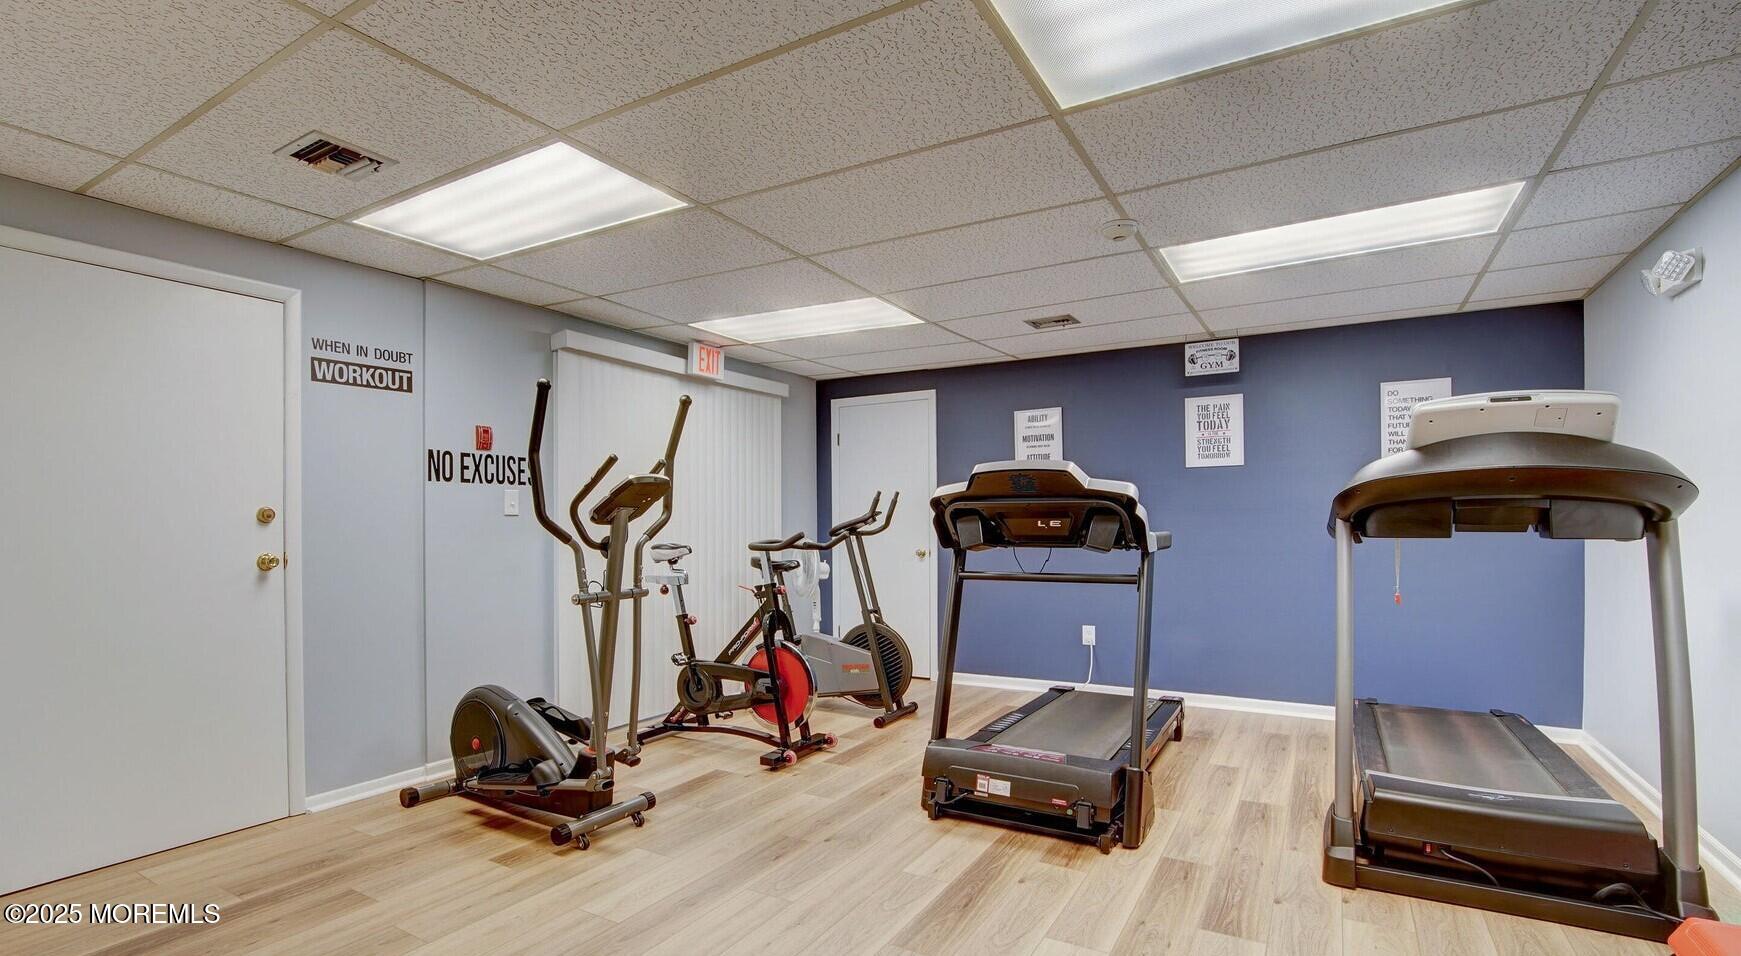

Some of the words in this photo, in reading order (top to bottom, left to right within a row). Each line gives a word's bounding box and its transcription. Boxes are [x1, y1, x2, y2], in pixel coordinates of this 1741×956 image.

[311, 337, 351, 355] WHEN
[356, 345, 368, 358] IN
[374, 348, 413, 364] DOUBT
[699, 346, 721, 375] EXIT
[1200, 361, 1223, 369] GYM
[313, 360, 411, 390] WORKOUT
[1387, 395, 1433, 405] SOMETHING
[1196, 404, 1211, 413] THE
[1212, 402, 1231, 411] PAIN
[1027, 414, 1048, 423] ABILITY
[1197, 412, 1211, 420] YOU
[1212, 411, 1231, 419] FEEL
[1196, 419, 1231, 431] TODAY
[1022, 433, 1055, 443] MOTIVATION
[1197, 437, 1231, 446] STRENGTH
[1197, 445, 1211, 453] YOU
[1212, 444, 1231, 452] FEEL
[1388, 446, 1404, 454] FOR
[1197, 451, 1231, 460] TOMORROW
[427, 449, 453, 482] NO
[460, 452, 532, 486] EXCUSE
